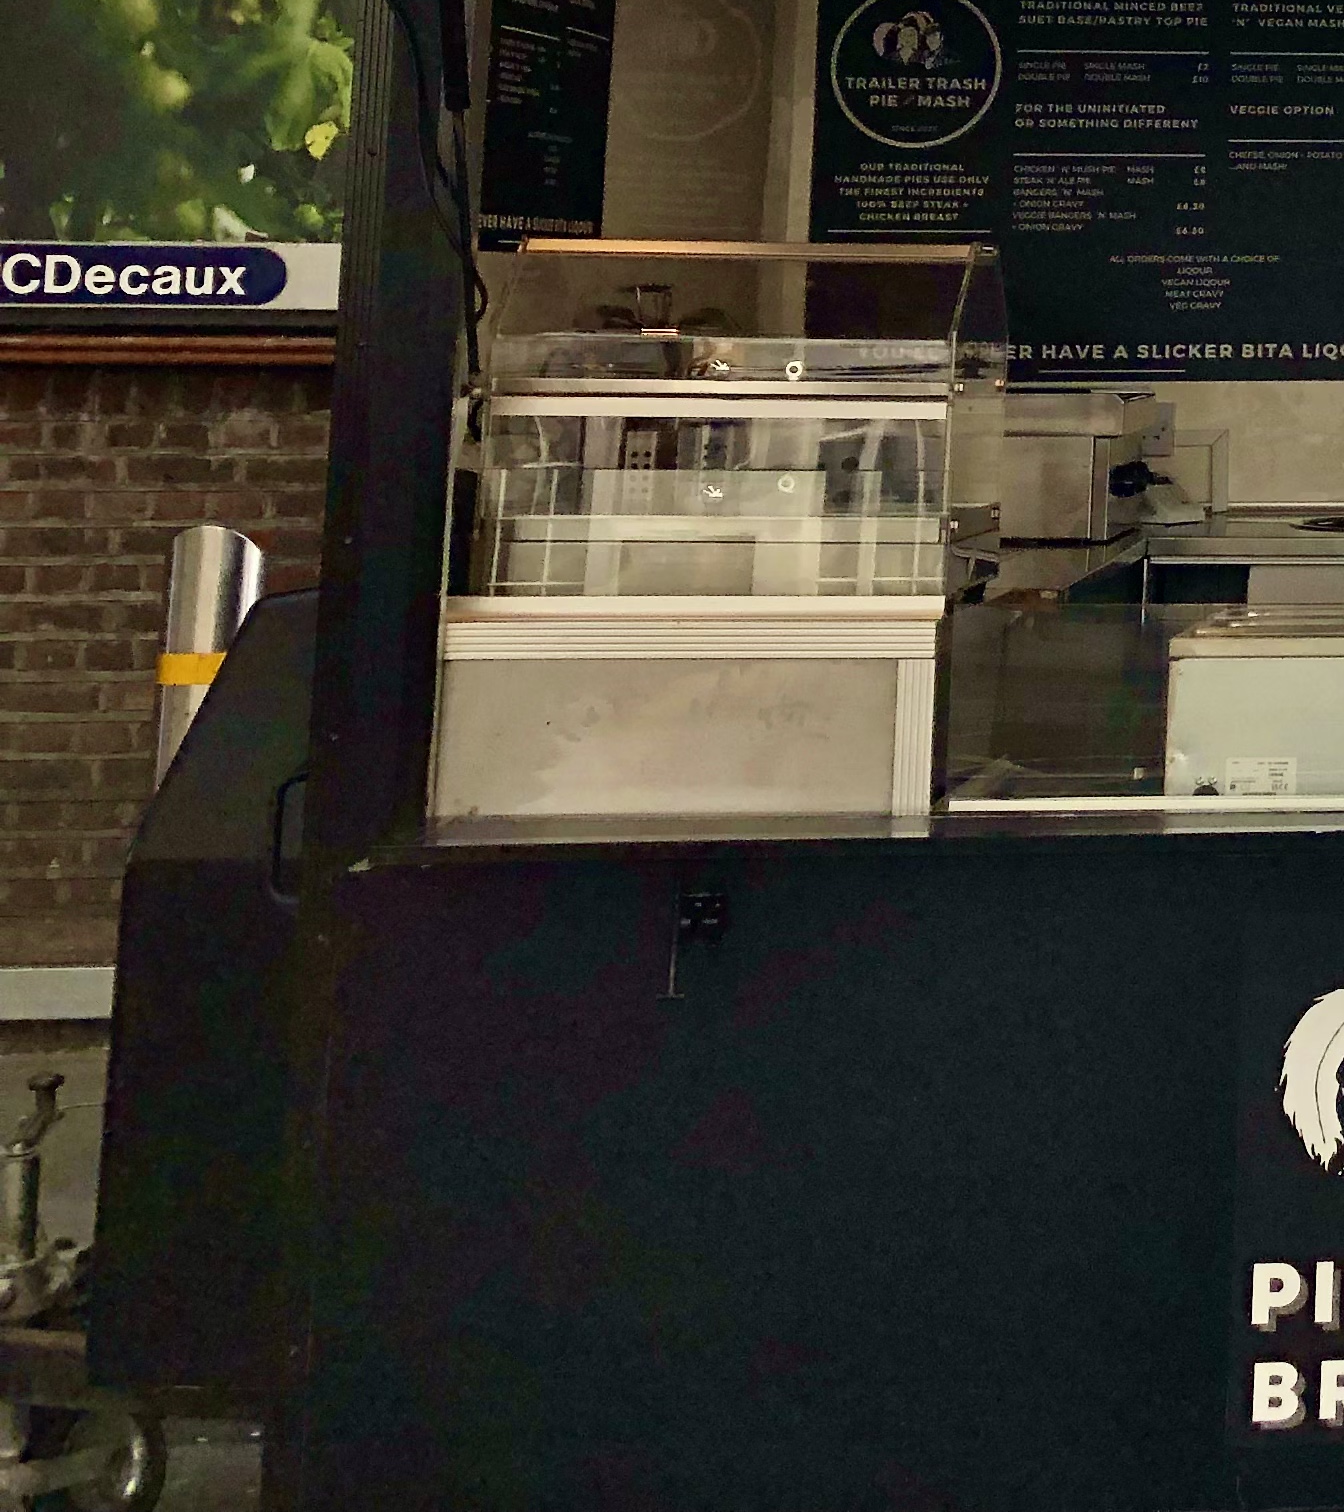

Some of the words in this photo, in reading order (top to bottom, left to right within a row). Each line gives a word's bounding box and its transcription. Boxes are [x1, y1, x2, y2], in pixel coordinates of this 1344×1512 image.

[1020, 0, 1110, 12] TRADITIONAL
[1113, 0, 1166, 12] MINCED
[1232, 3, 1322, 14] TRADITIONAL
[1186, 15, 1208, 26] PIE
[1258, 17, 1304, 28] VEGAN
[845, 76, 920, 91] TRAILER
[926, 76, 988, 91] TRASH
[869, 94, 898, 108] PIE
[917, 94, 971, 109] MASH
[1015, 103, 1042, 114] FOR
[1047, 103, 1073, 114] THE
[1230, 105, 1279, 115] VEGGIE
[1283, 105, 1335, 115] OPTION
[1014, 118, 1035, 129] OR
[1038, 118, 1120, 129] SOMETHING
[1123, 118, 1200, 129] DIFFERENT
[860, 162, 885, 172] OUR
[888, 162, 965, 172] TRADITIONAL
[904, 175, 929, 185] PIES
[839, 186, 860, 197] THE
[859, 211, 911, 222] CHICKEN
[1161, 278, 1194, 287] VEGAN
[1042, 344, 1105, 359] HAVE
[1113, 344, 1129, 359] A
[1136, 344, 1233, 359] SLICKER
[1241, 343, 1294, 359] BITA
